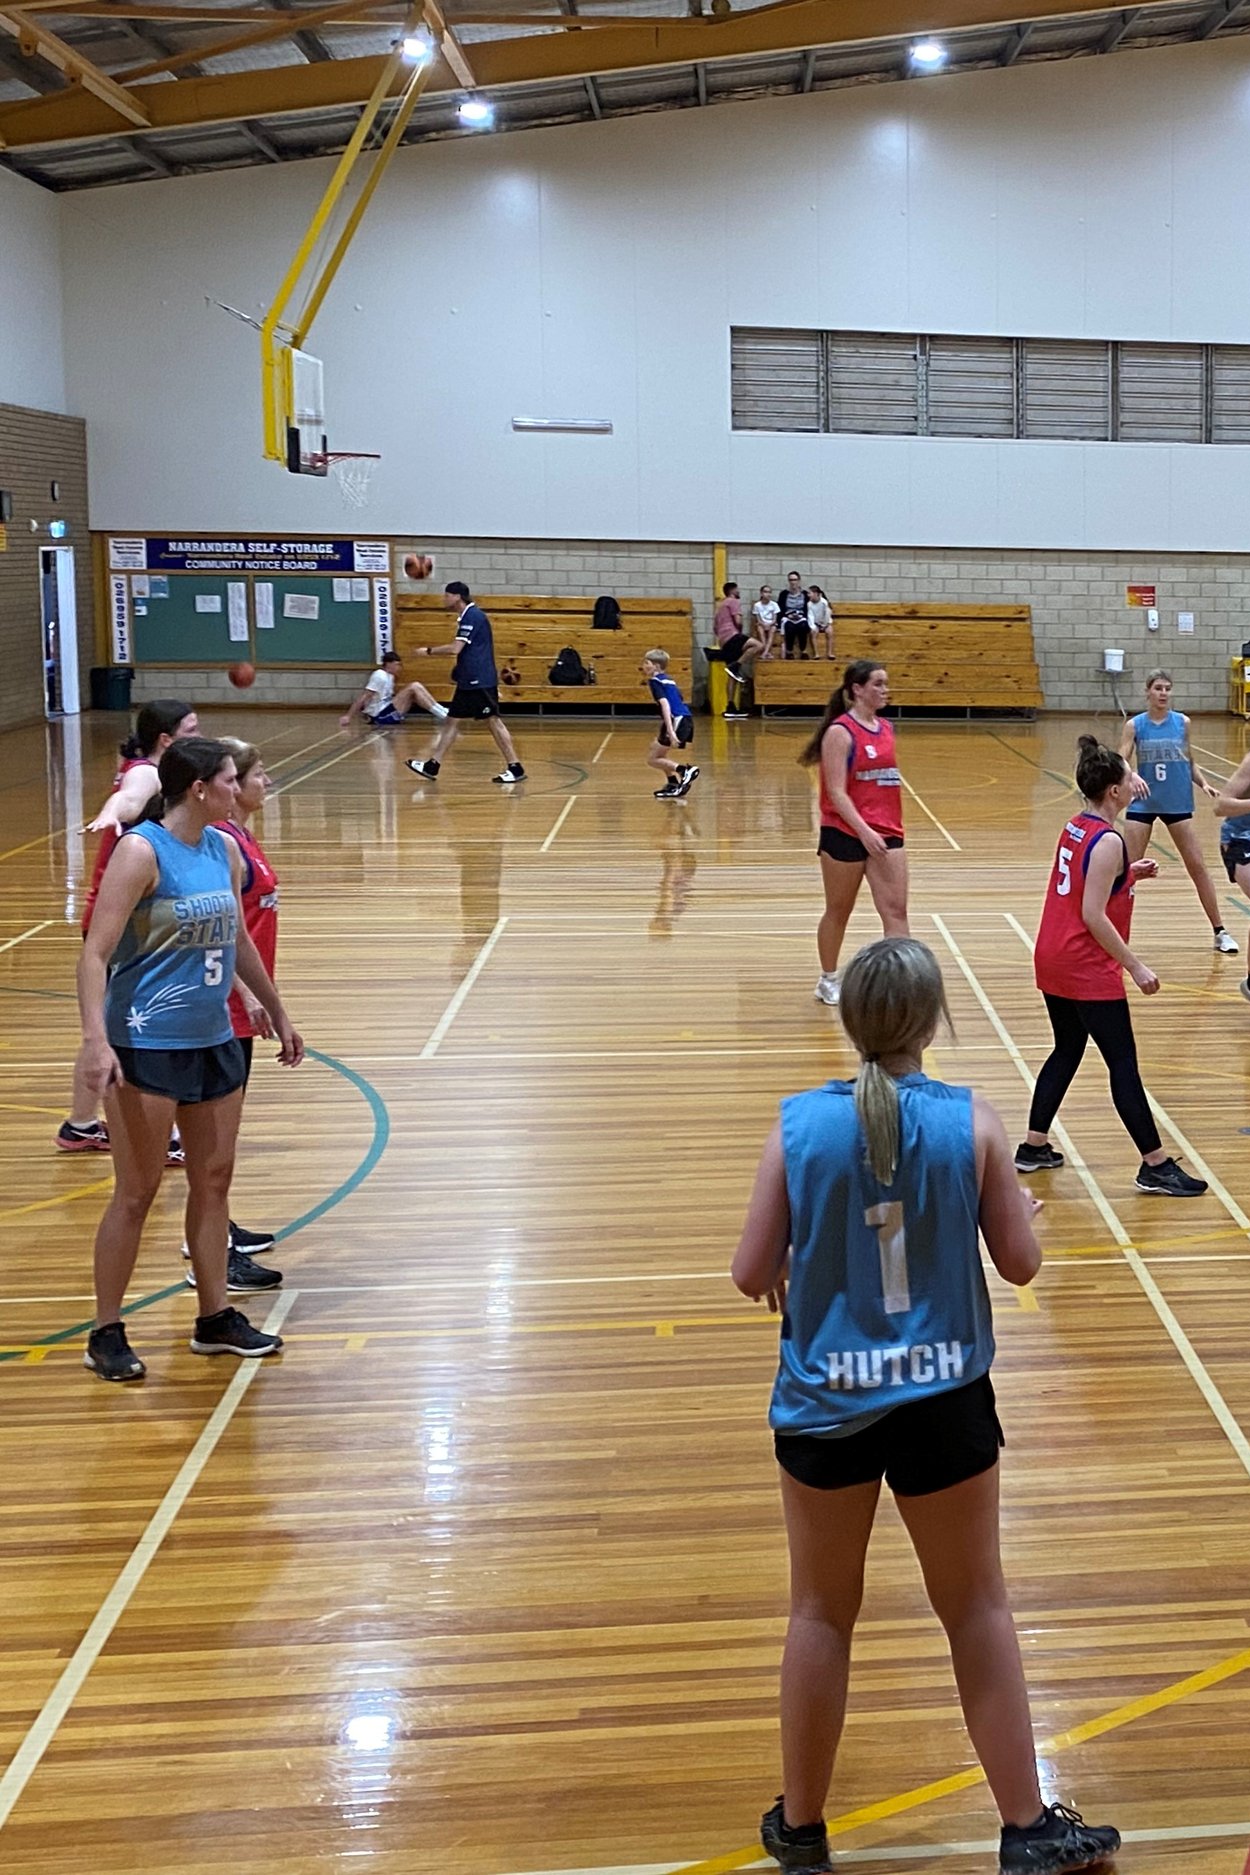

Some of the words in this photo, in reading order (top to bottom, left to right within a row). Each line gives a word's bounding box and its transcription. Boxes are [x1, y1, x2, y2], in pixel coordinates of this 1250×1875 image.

[168, 542, 246, 552] NARRANDERA
[248, 542, 334, 554] SELF-STORAGE
[185, 560, 244, 569] COMMUNITY
[245, 561, 281, 569] NOTICE
[282, 561, 318, 570] BOARD
[1155, 763, 1167, 781] 6
[1056, 846, 1073, 896] 5
[204, 949, 224, 986] 5
[864, 1200, 912, 1314] 1
[826, 1340, 963, 1390] HUTCH
